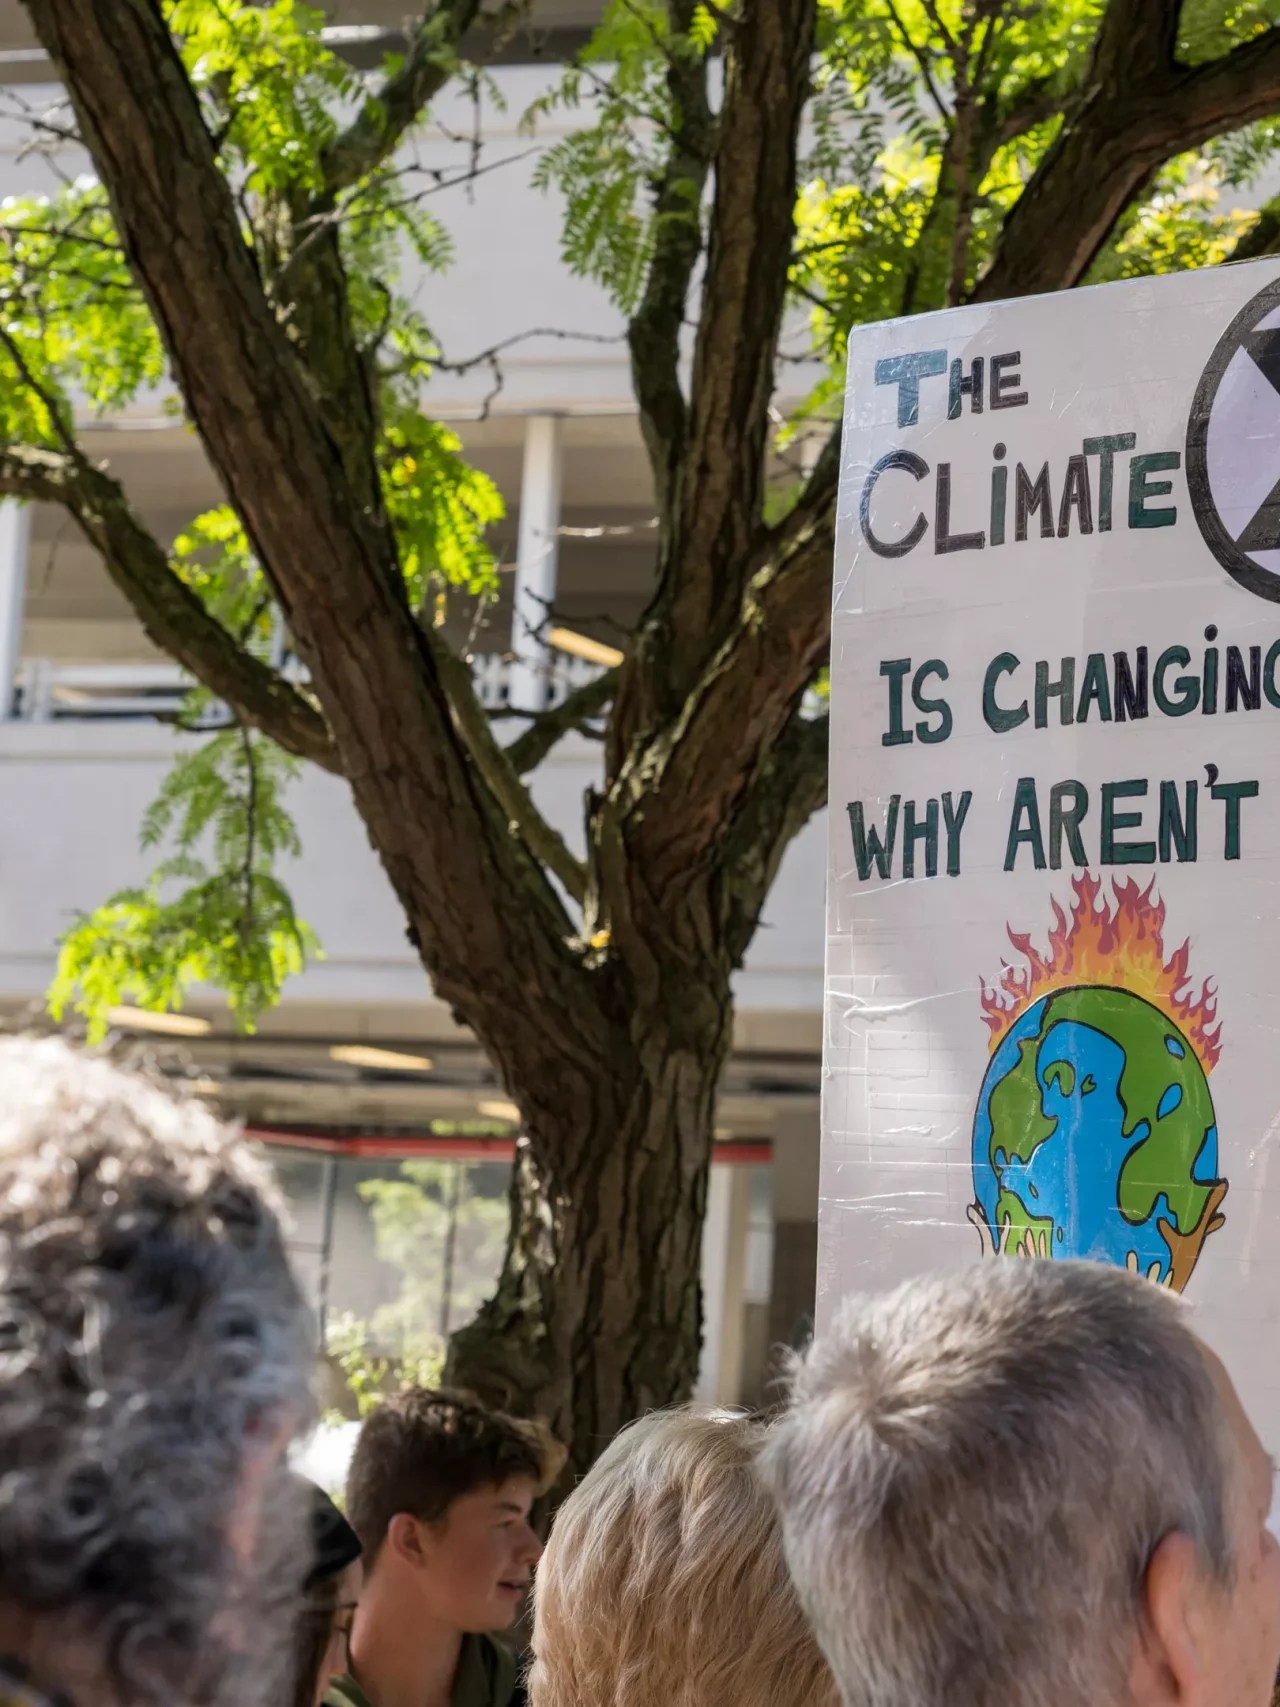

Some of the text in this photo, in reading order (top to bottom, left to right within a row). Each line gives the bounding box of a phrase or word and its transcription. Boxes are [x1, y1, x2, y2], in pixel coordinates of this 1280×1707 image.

[874, 348, 1029, 429] THE
[879, 656, 954, 746] IS
[846, 789, 973, 881] WHY
[1002, 762, 1260, 873] AREN'T
